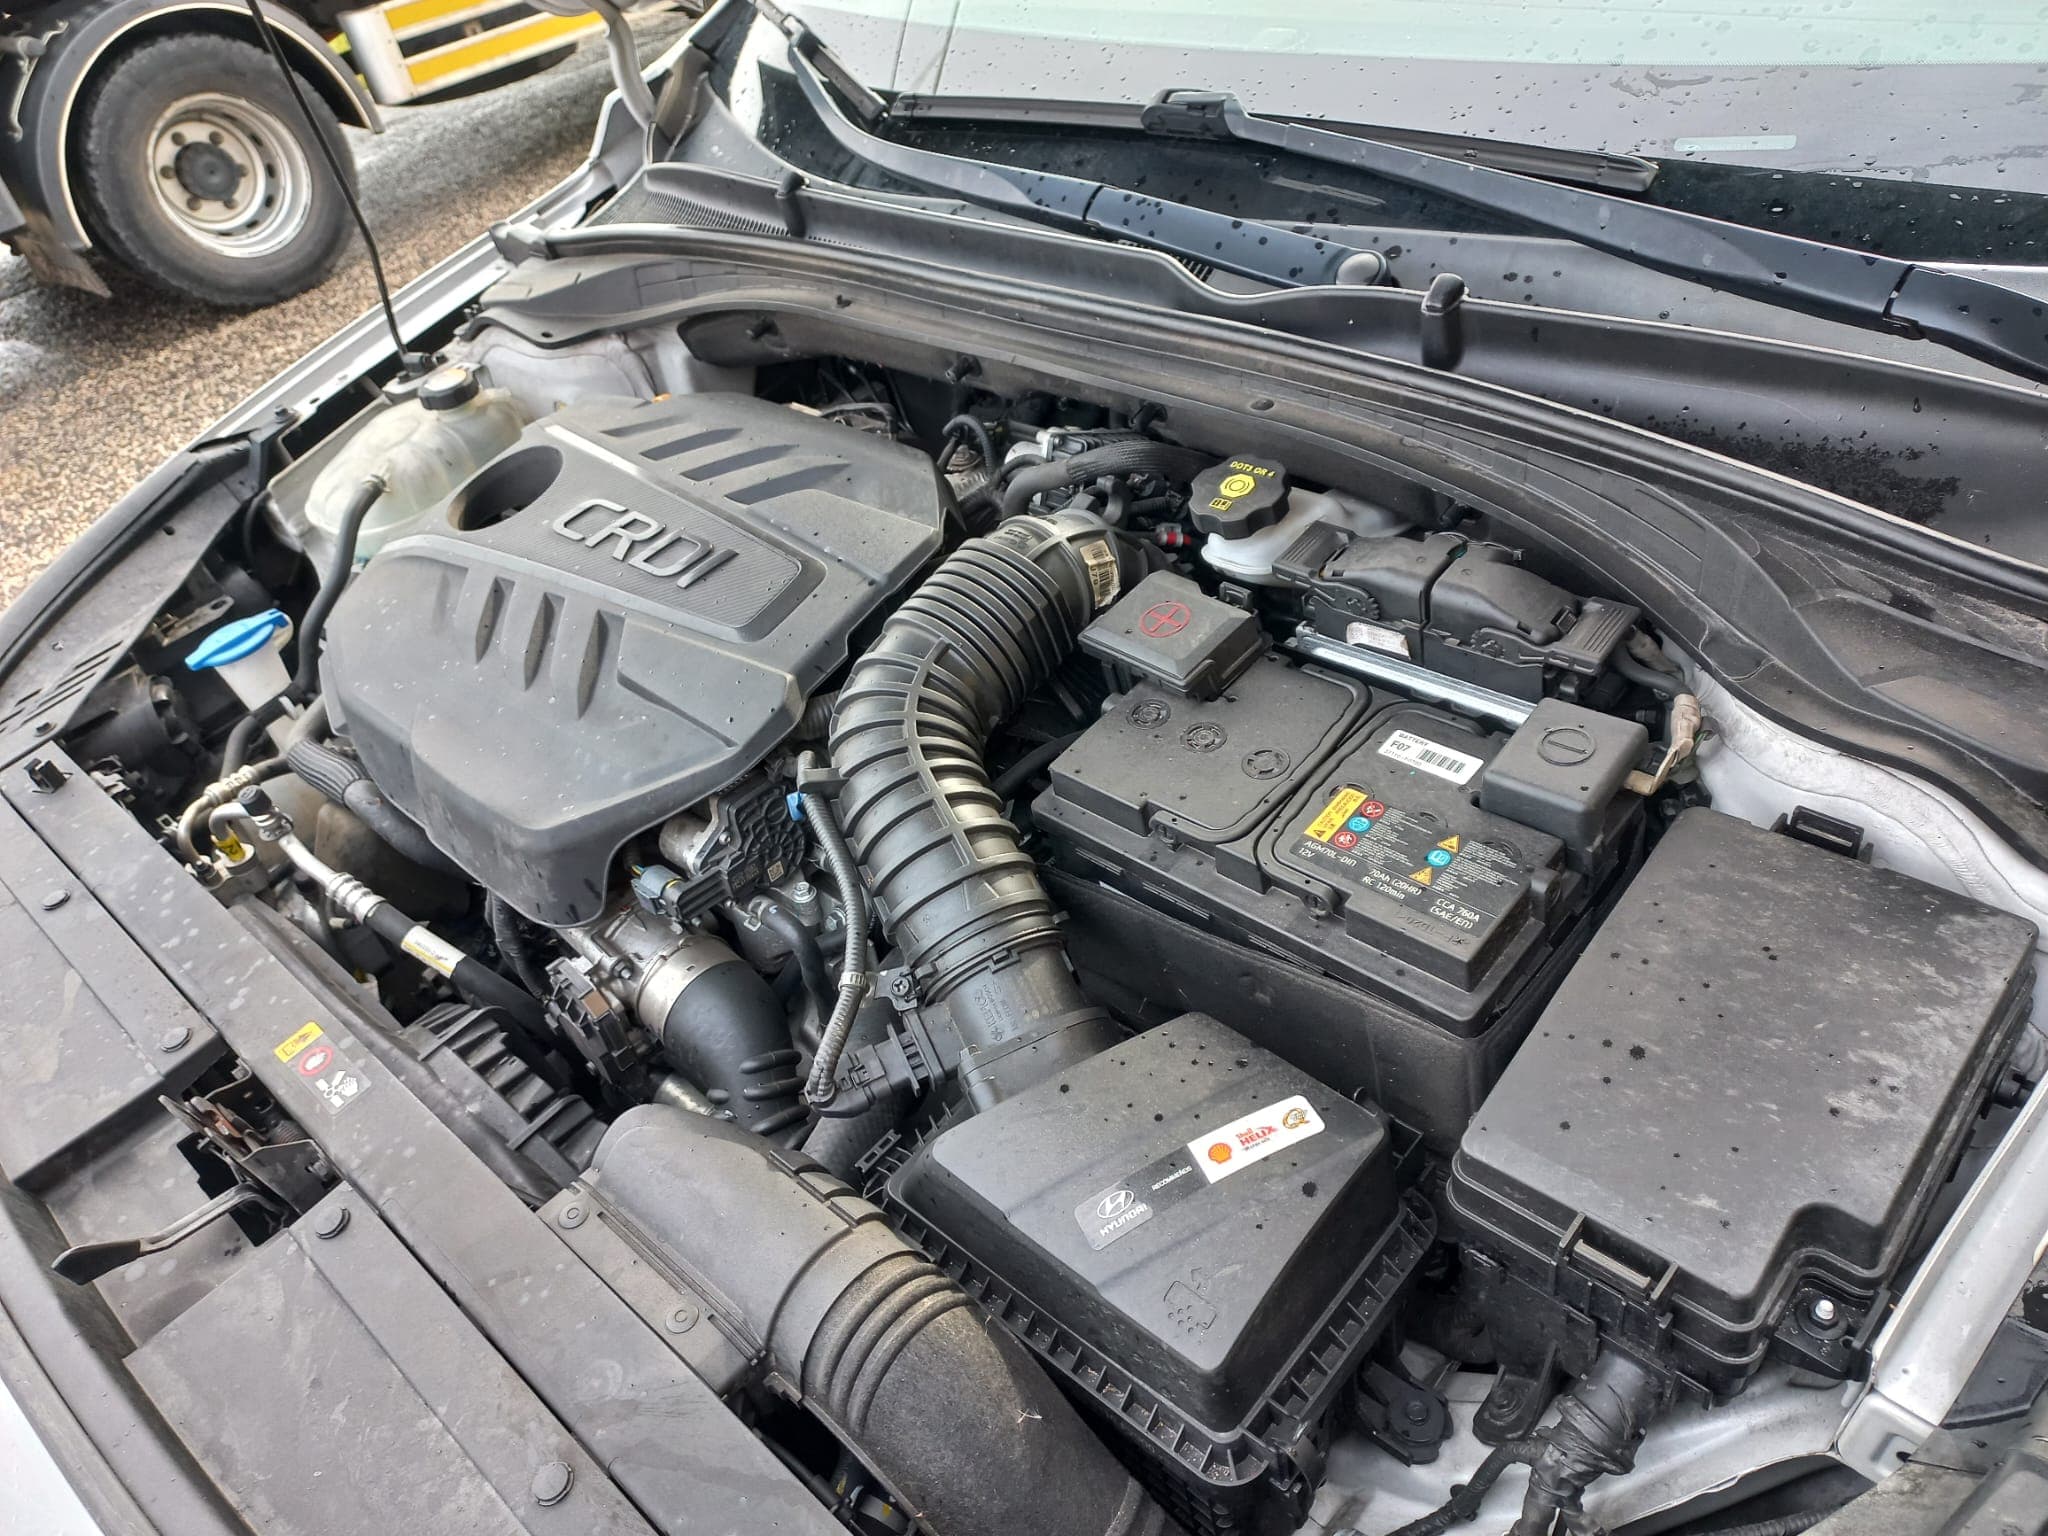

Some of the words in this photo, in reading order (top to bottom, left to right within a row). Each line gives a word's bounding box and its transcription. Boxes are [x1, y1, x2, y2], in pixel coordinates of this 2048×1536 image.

[1229, 461, 1253, 473] DOT3
[1254, 466, 1268, 476] OR
[552, 498, 739, 589] CRDI
[1389, 740, 1412, 752] F07
[1398, 732, 1430, 747] BATTERY
[1298, 847, 1316, 858] 12V
[1303, 840, 1358, 867] AGM70L-DIN
[1361, 875, 1376, 886] RC
[1376, 881, 1406, 900] 120min
[1368, 868, 1391, 882] 70Ah
[1391, 877, 1423, 896] (20HR)
[1429, 905, 1474, 929] (SAE/EN)
[1436, 898, 1456, 911] CCA
[1456, 906, 1480, 922] 760A
[1239, 1125, 1278, 1147] HELIX
[1099, 1202, 1149, 1237] HYUNDAI
